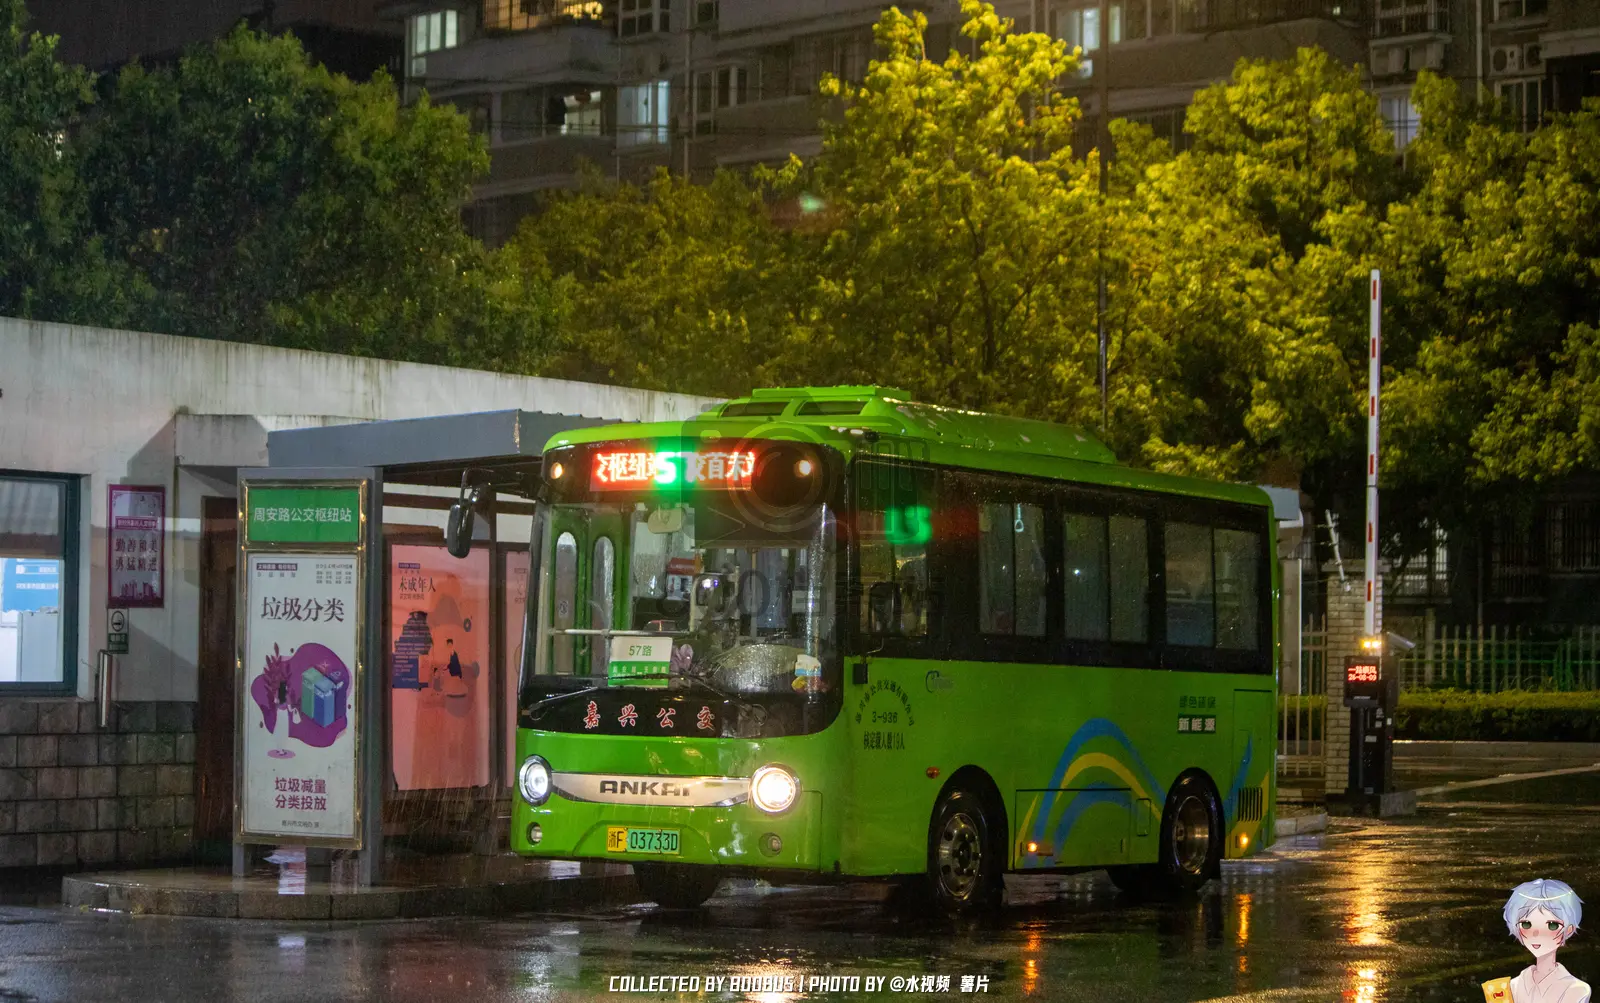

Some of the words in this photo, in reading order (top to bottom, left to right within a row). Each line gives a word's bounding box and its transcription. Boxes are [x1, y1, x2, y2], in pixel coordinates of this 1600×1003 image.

[253, 507, 352, 522] 周安路公交枢纽站
[261, 596, 345, 622] 垃圾分类
[628, 645, 652, 656] 57路
[583, 700, 716, 731] 嘉兴公交
[275, 776, 327, 794] 垃圾减量
[599, 780, 690, 797] ANKAI
[275, 794, 327, 811] 分类投放
[630, 831, 678, 851] 03733D
